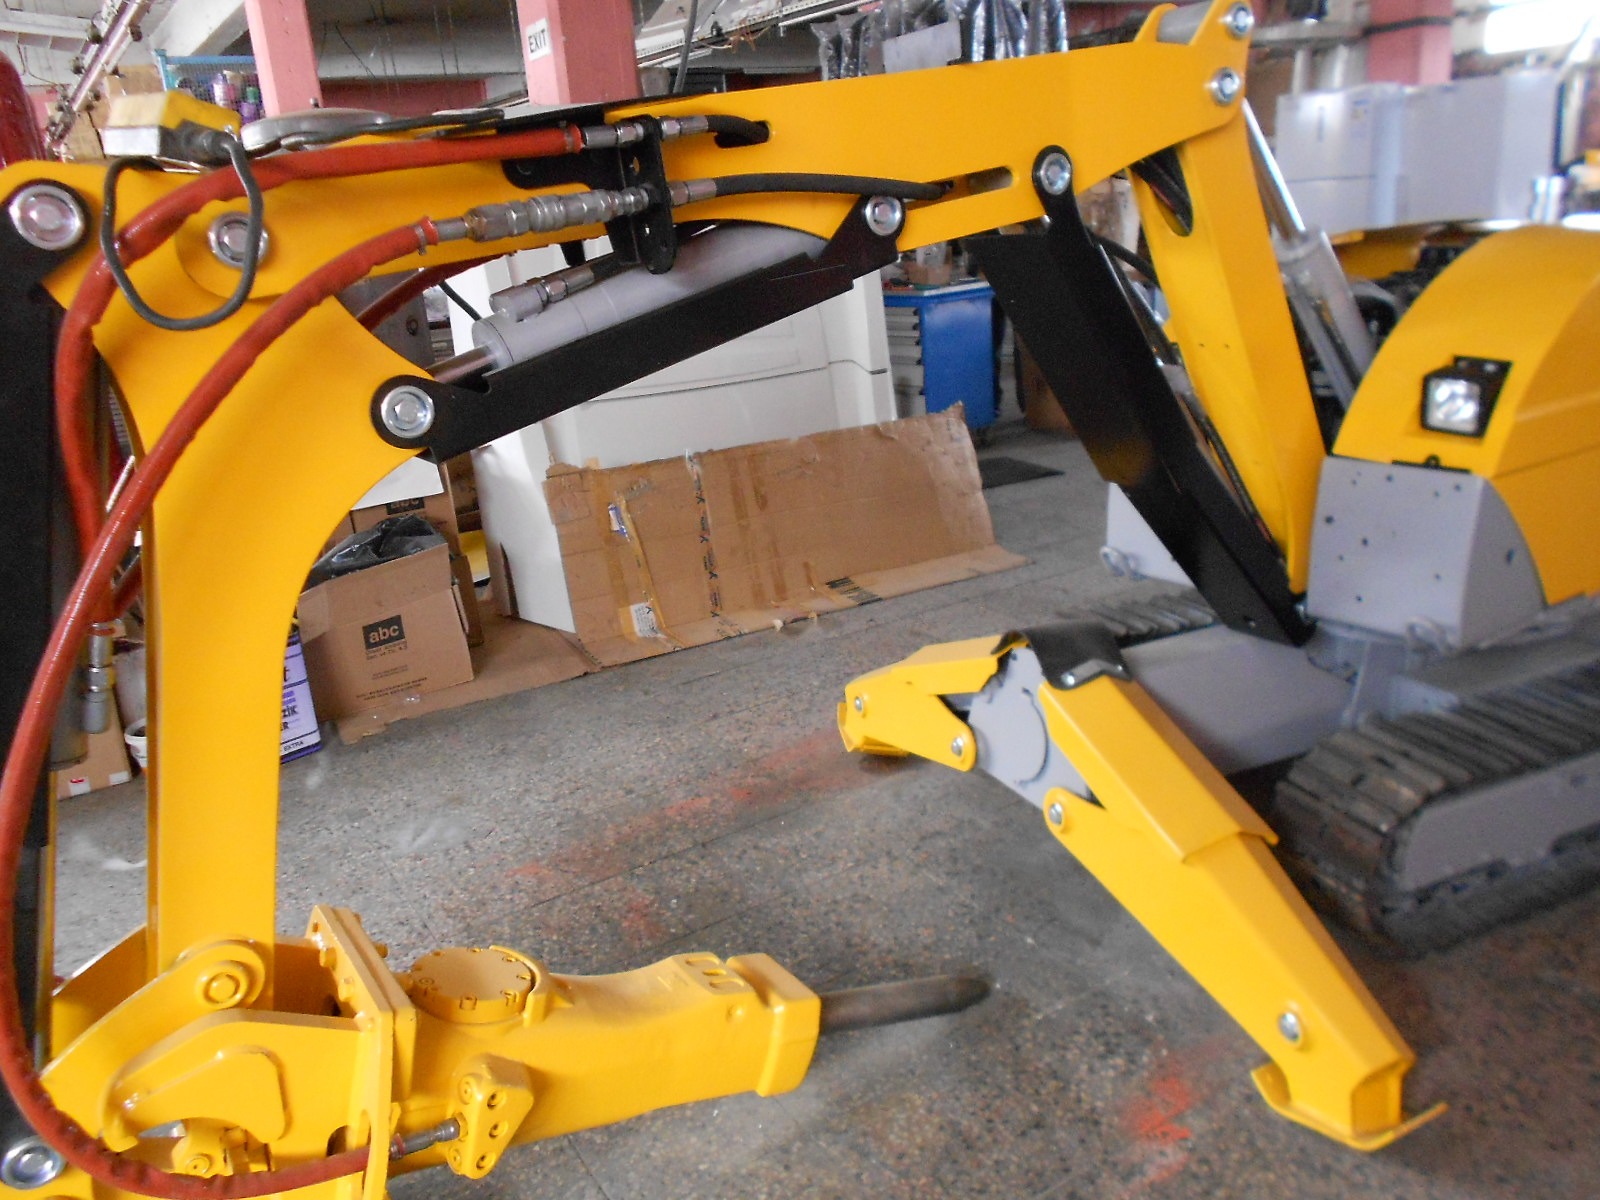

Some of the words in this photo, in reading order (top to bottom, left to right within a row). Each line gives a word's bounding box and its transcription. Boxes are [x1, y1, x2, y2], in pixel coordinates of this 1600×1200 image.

[528, 28, 546, 53] EXIT
[369, 625, 400, 643] abc
[283, 741, 304, 752] EXTRA
